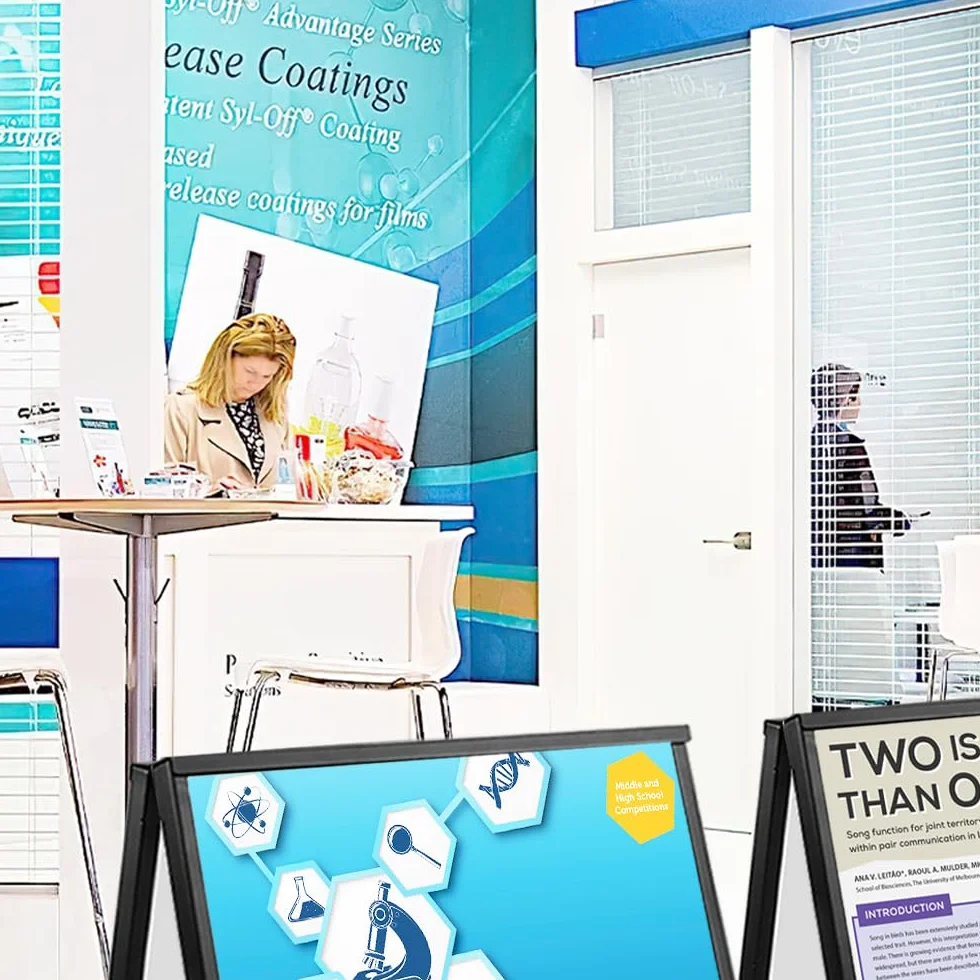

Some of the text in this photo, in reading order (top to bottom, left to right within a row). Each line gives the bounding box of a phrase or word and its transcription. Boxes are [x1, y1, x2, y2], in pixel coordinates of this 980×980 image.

[263, 2, 442, 54] Advantage Series
[165, 43, 408, 112] ease Coatings
[320, 113, 401, 152] Coating
[247, 191, 337, 223] coatings
[338, 196, 373, 225] for
[375, 200, 428, 229] films
[828, 735, 941, 778] TWO
[949, 732, 980, 760] IS
[837, 783, 940, 818] THAN
[846, 830, 870, 839] Song
[871, 826, 909, 836] function
[910, 823, 923, 831] for
[925, 821, 945, 832] joint
[848, 842, 877, 852] within
[878, 840, 896, 851] pair
[899, 833, 966, 847] communication
[967, 831, 976, 839] in
[864, 901, 944, 919] INTRODUCTION
